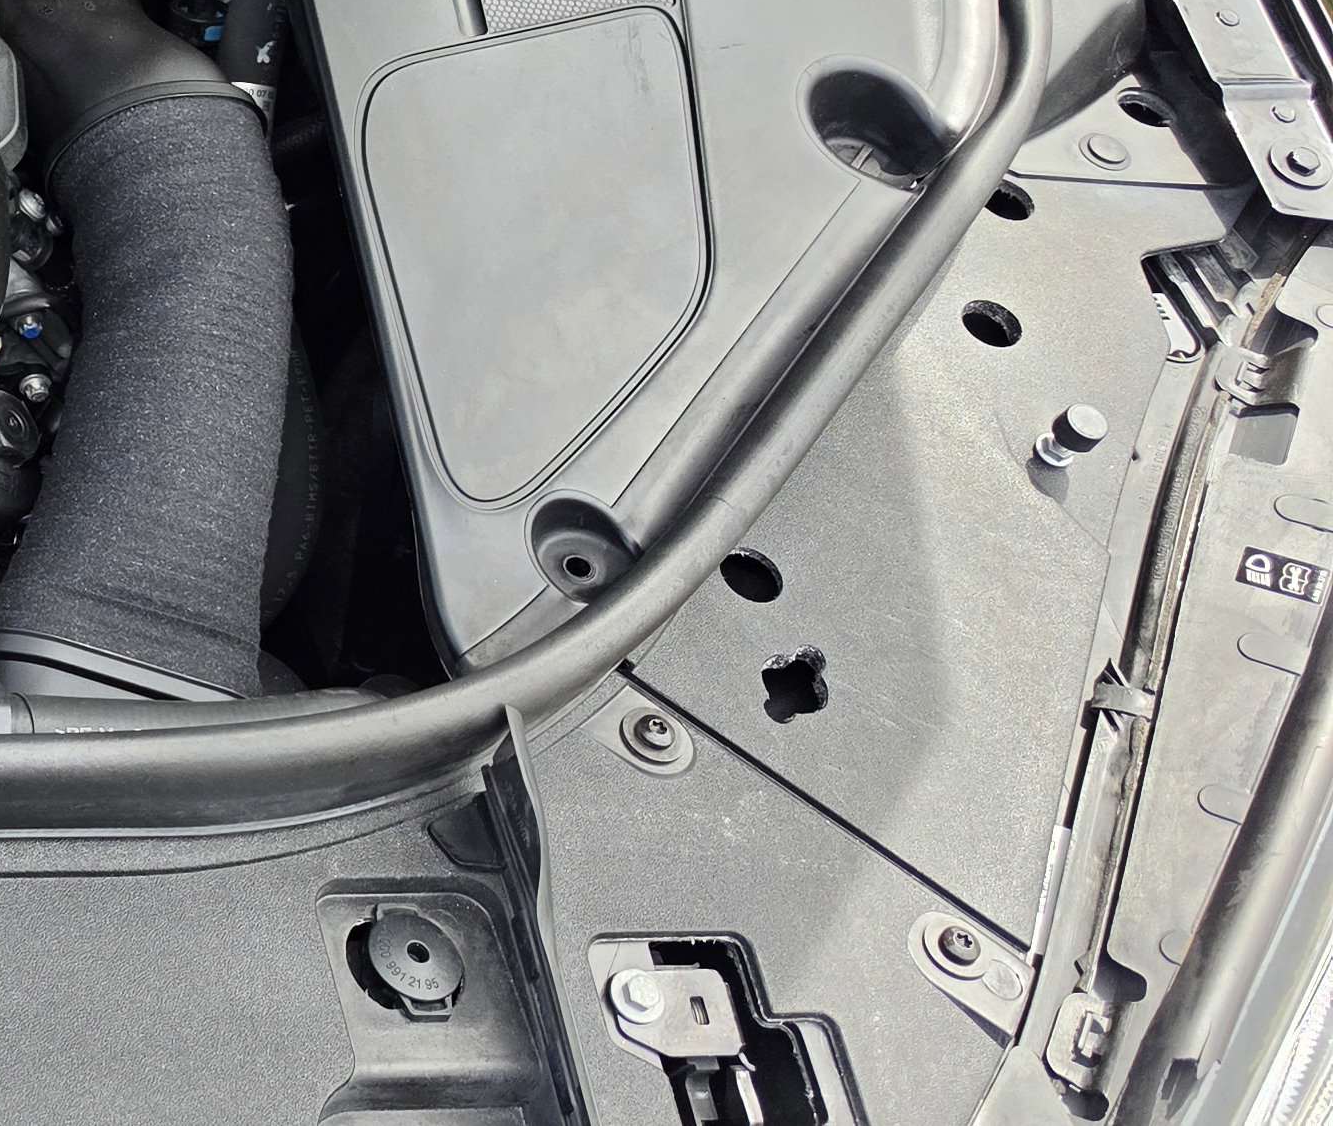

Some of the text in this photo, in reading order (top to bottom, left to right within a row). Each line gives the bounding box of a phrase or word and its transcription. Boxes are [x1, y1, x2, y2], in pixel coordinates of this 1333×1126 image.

[386, 961, 407, 981] 991
[408, 976, 421, 989] 21
[425, 977, 439, 990] 95
